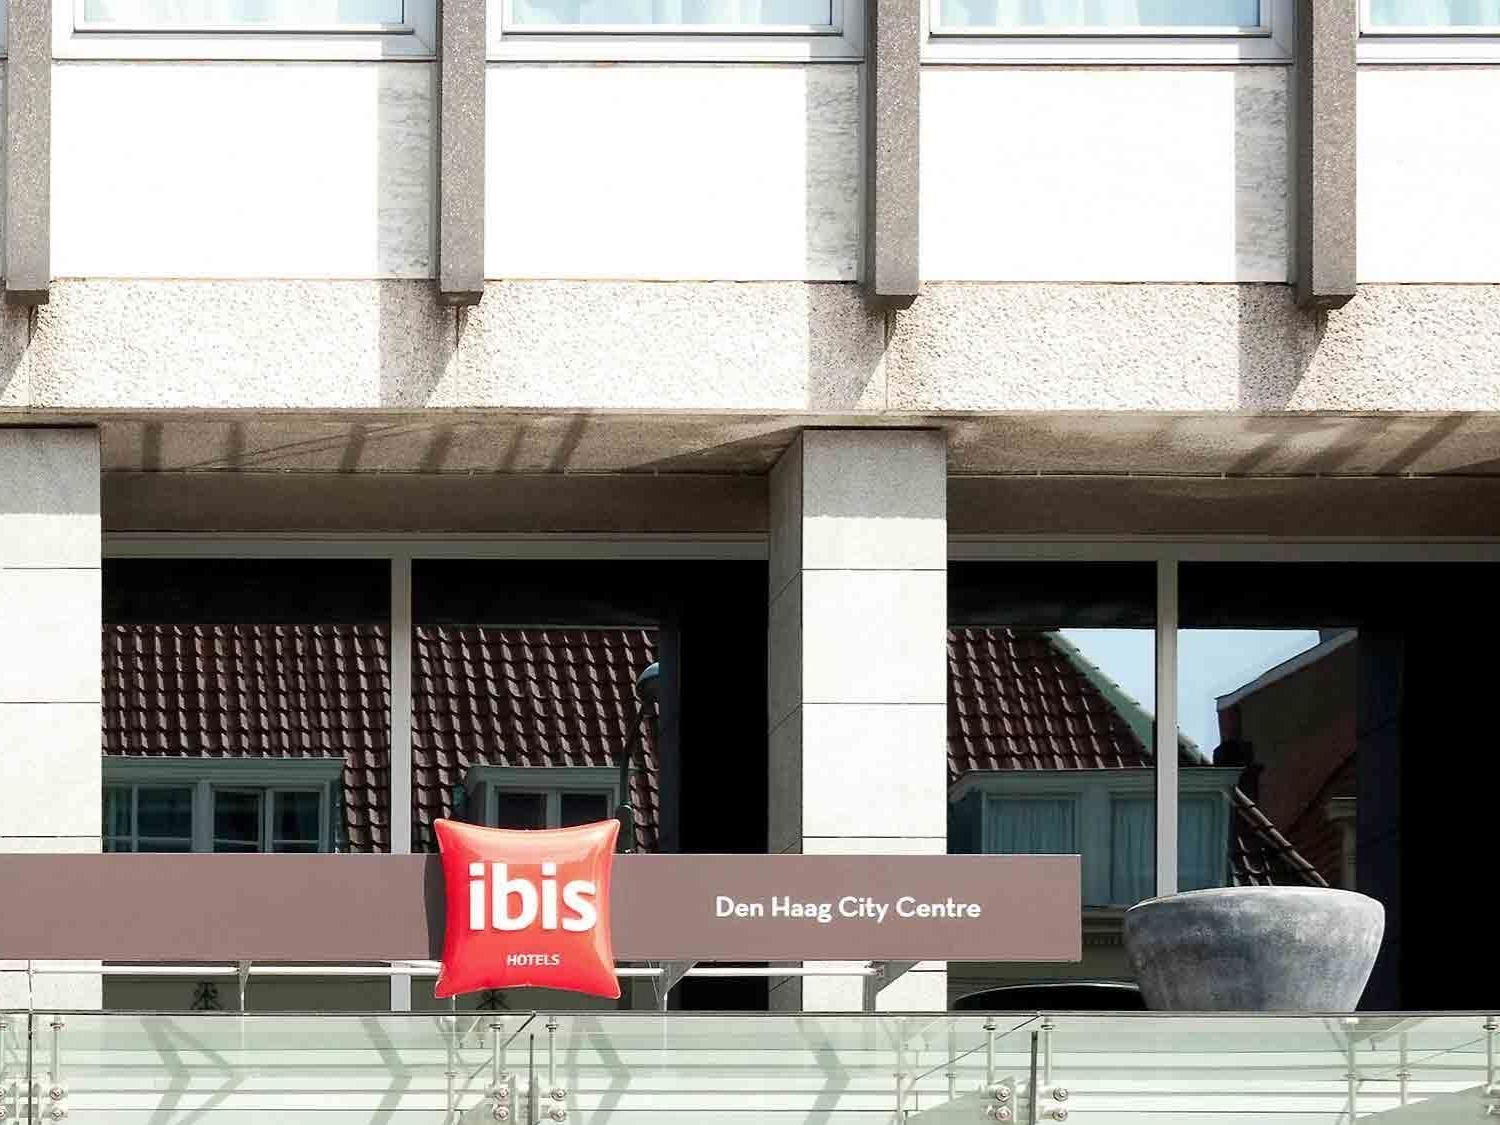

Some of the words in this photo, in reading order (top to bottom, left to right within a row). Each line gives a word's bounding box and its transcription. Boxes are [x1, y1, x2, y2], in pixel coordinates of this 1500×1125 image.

[468, 862, 598, 932] ibis
[715, 896, 764, 918] Den
[771, 896, 832, 923] Haag
[838, 896, 889, 923] City
[895, 896, 981, 918] Centre
[506, 953, 561, 967] HOTELS
